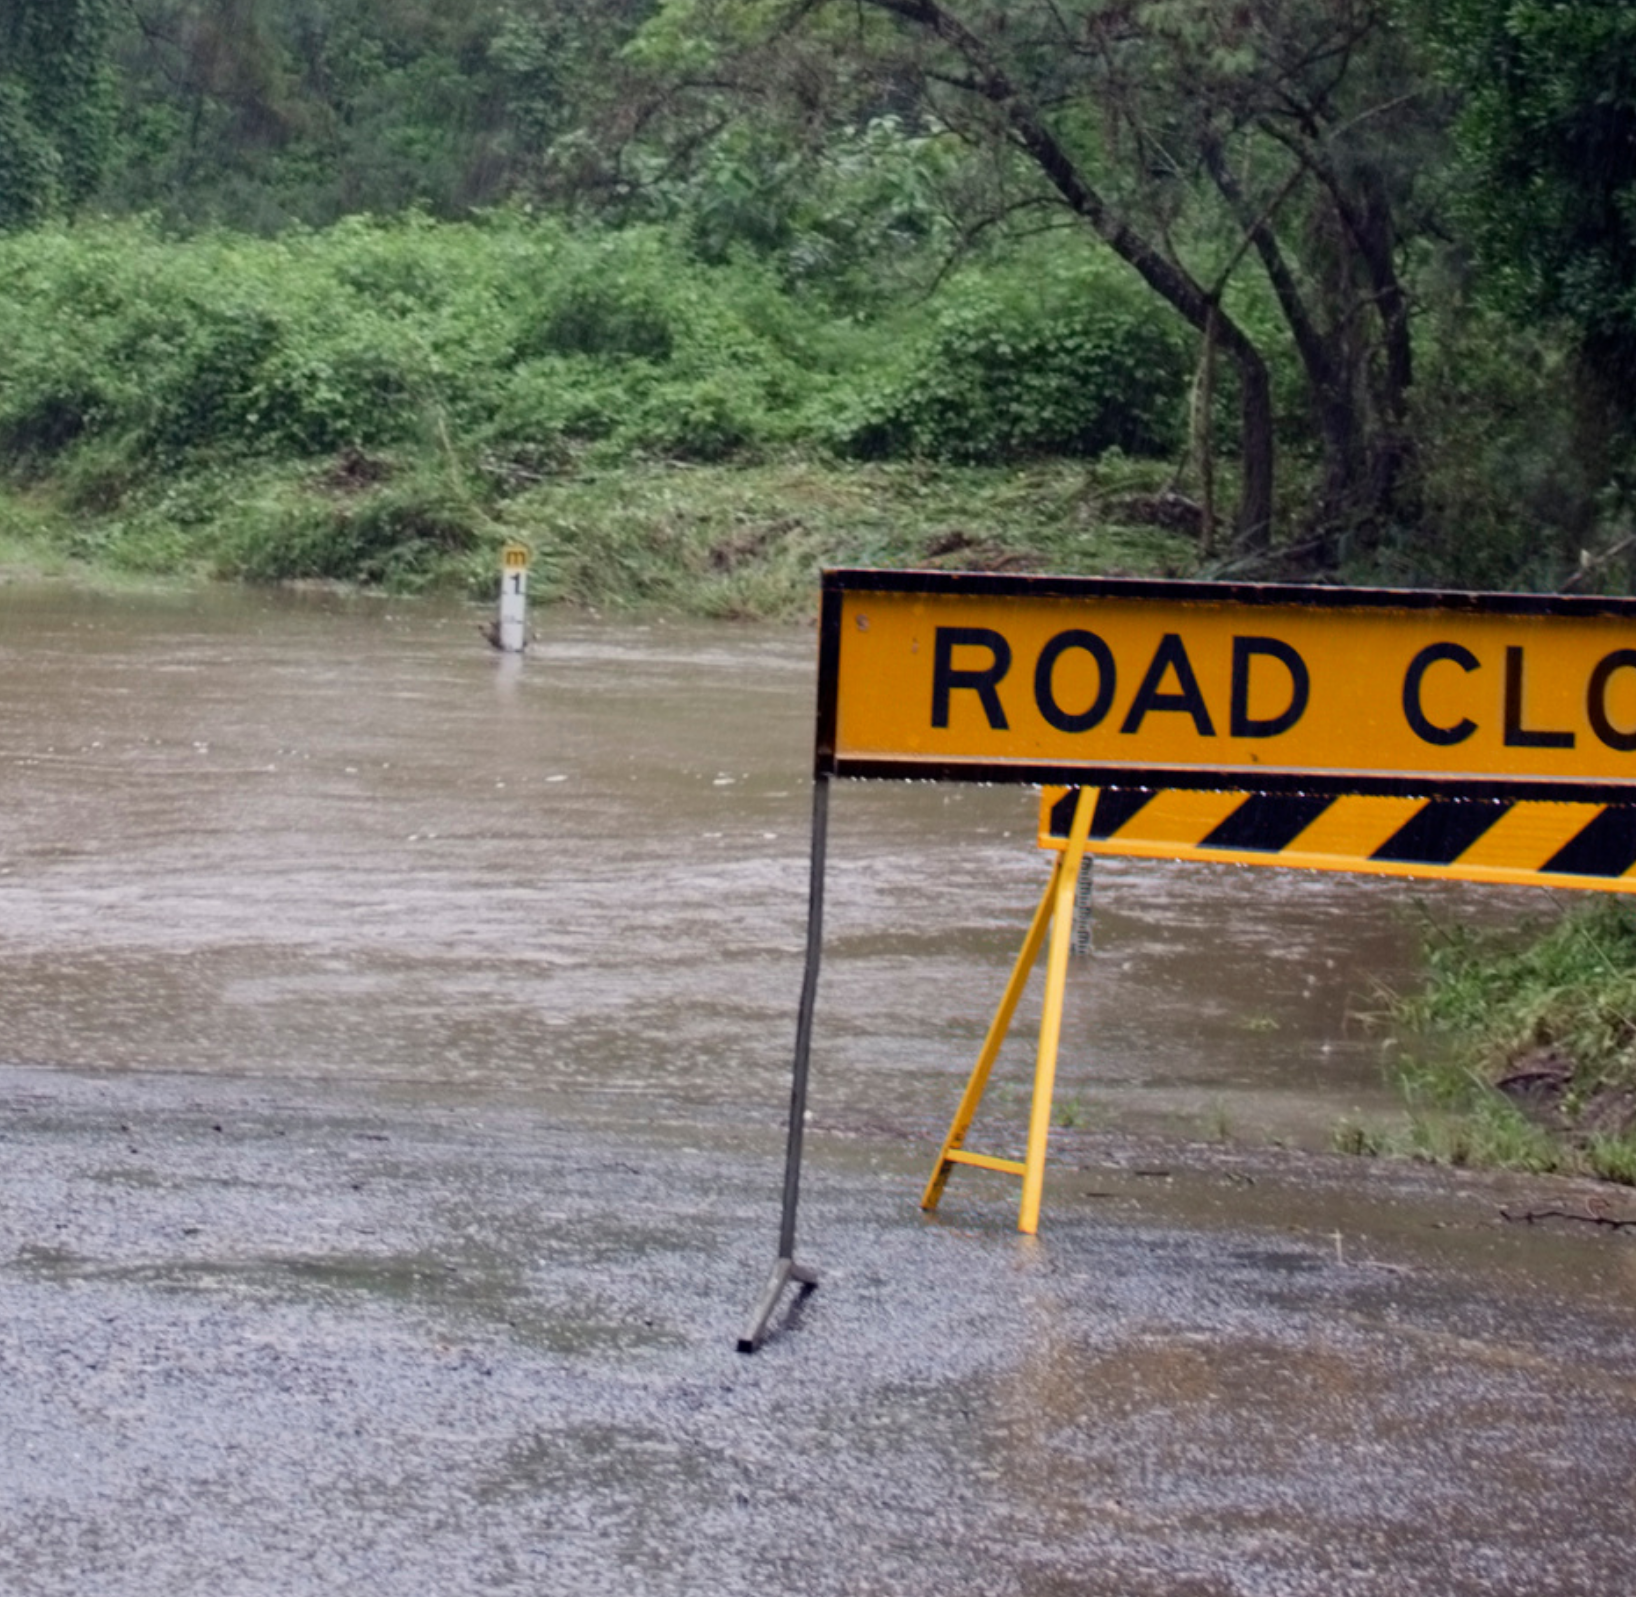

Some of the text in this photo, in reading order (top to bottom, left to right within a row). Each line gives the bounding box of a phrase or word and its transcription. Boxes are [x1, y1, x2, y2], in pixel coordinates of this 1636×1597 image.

[505, 551, 526, 567] m
[509, 573, 521, 595] 1
[932, 627, 1309, 738] ROAD
